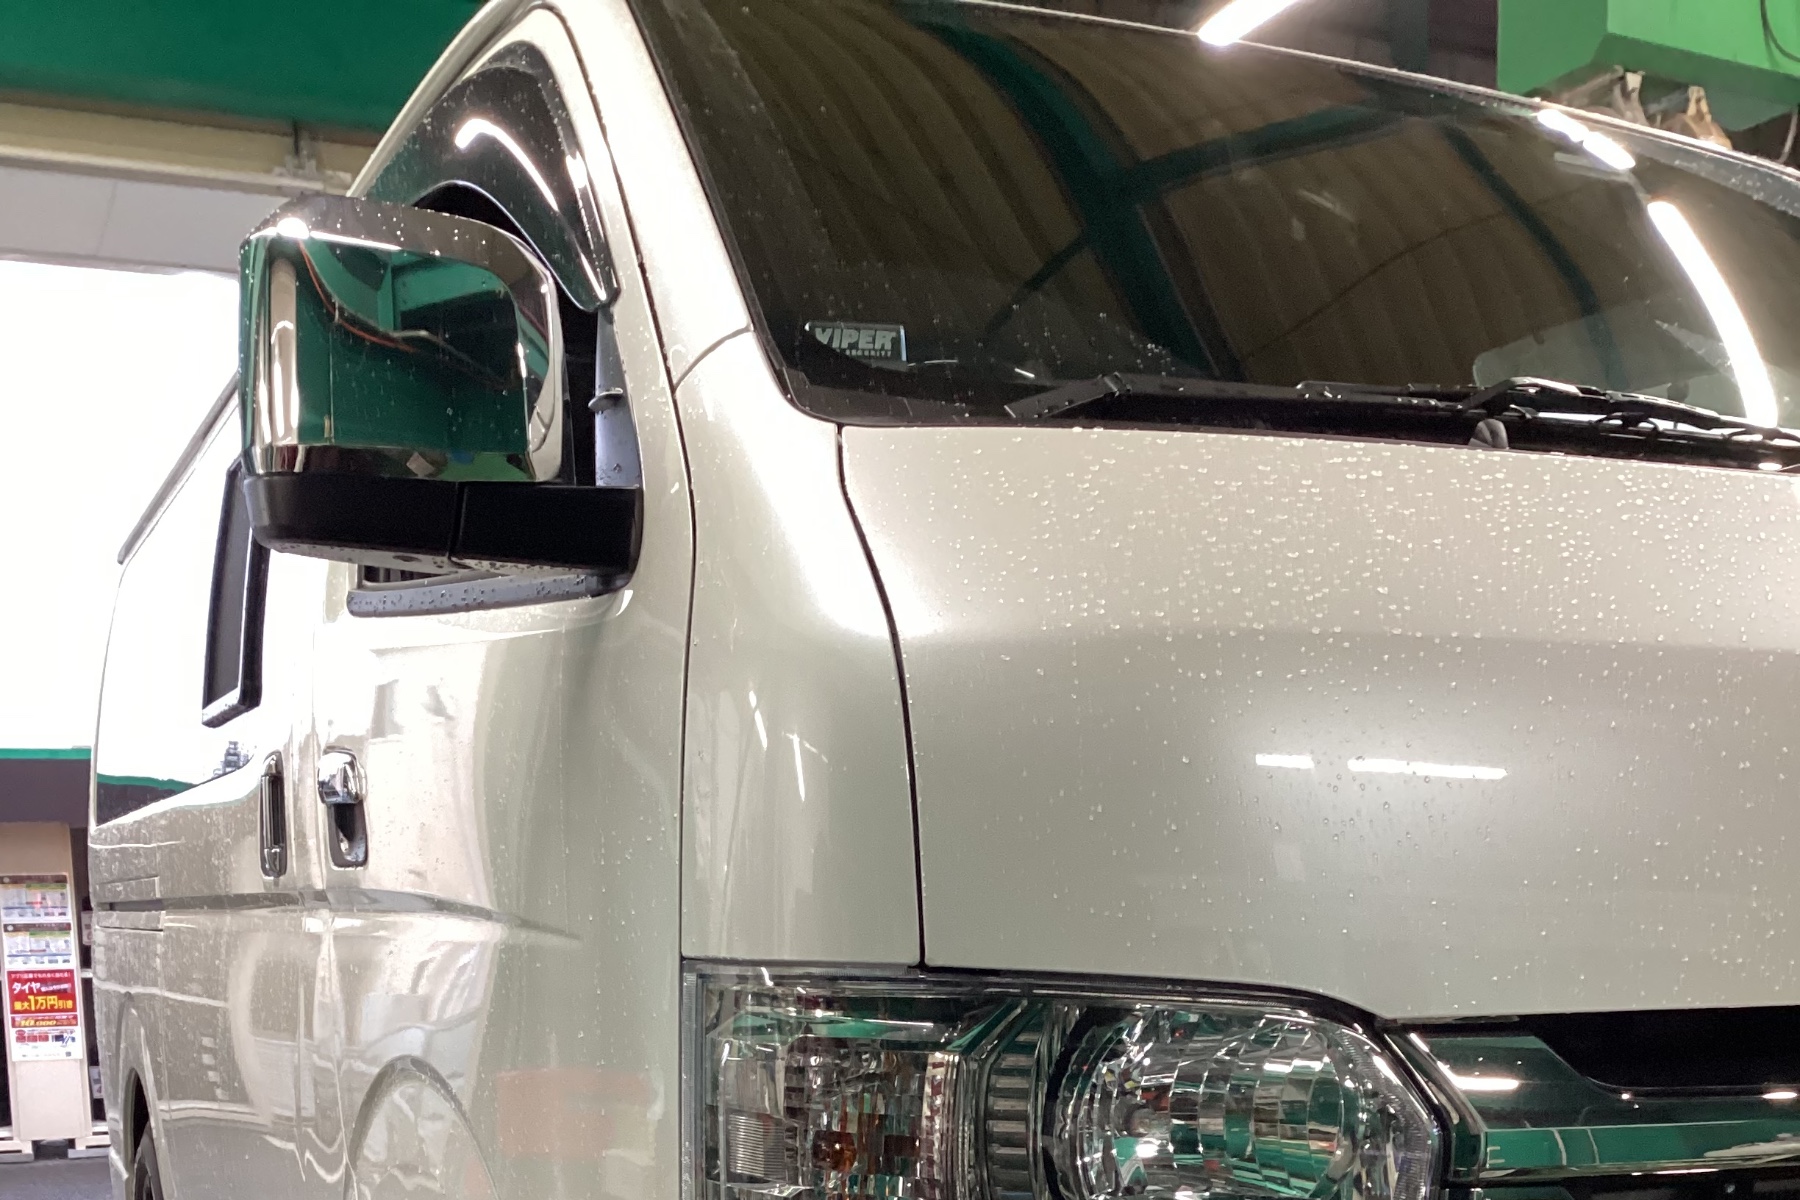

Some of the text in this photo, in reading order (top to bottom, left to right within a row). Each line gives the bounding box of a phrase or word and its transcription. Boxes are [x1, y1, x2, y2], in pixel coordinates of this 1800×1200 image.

[814, 327, 897, 350] VIPER
[12, 981, 41, 995] タイヤ
